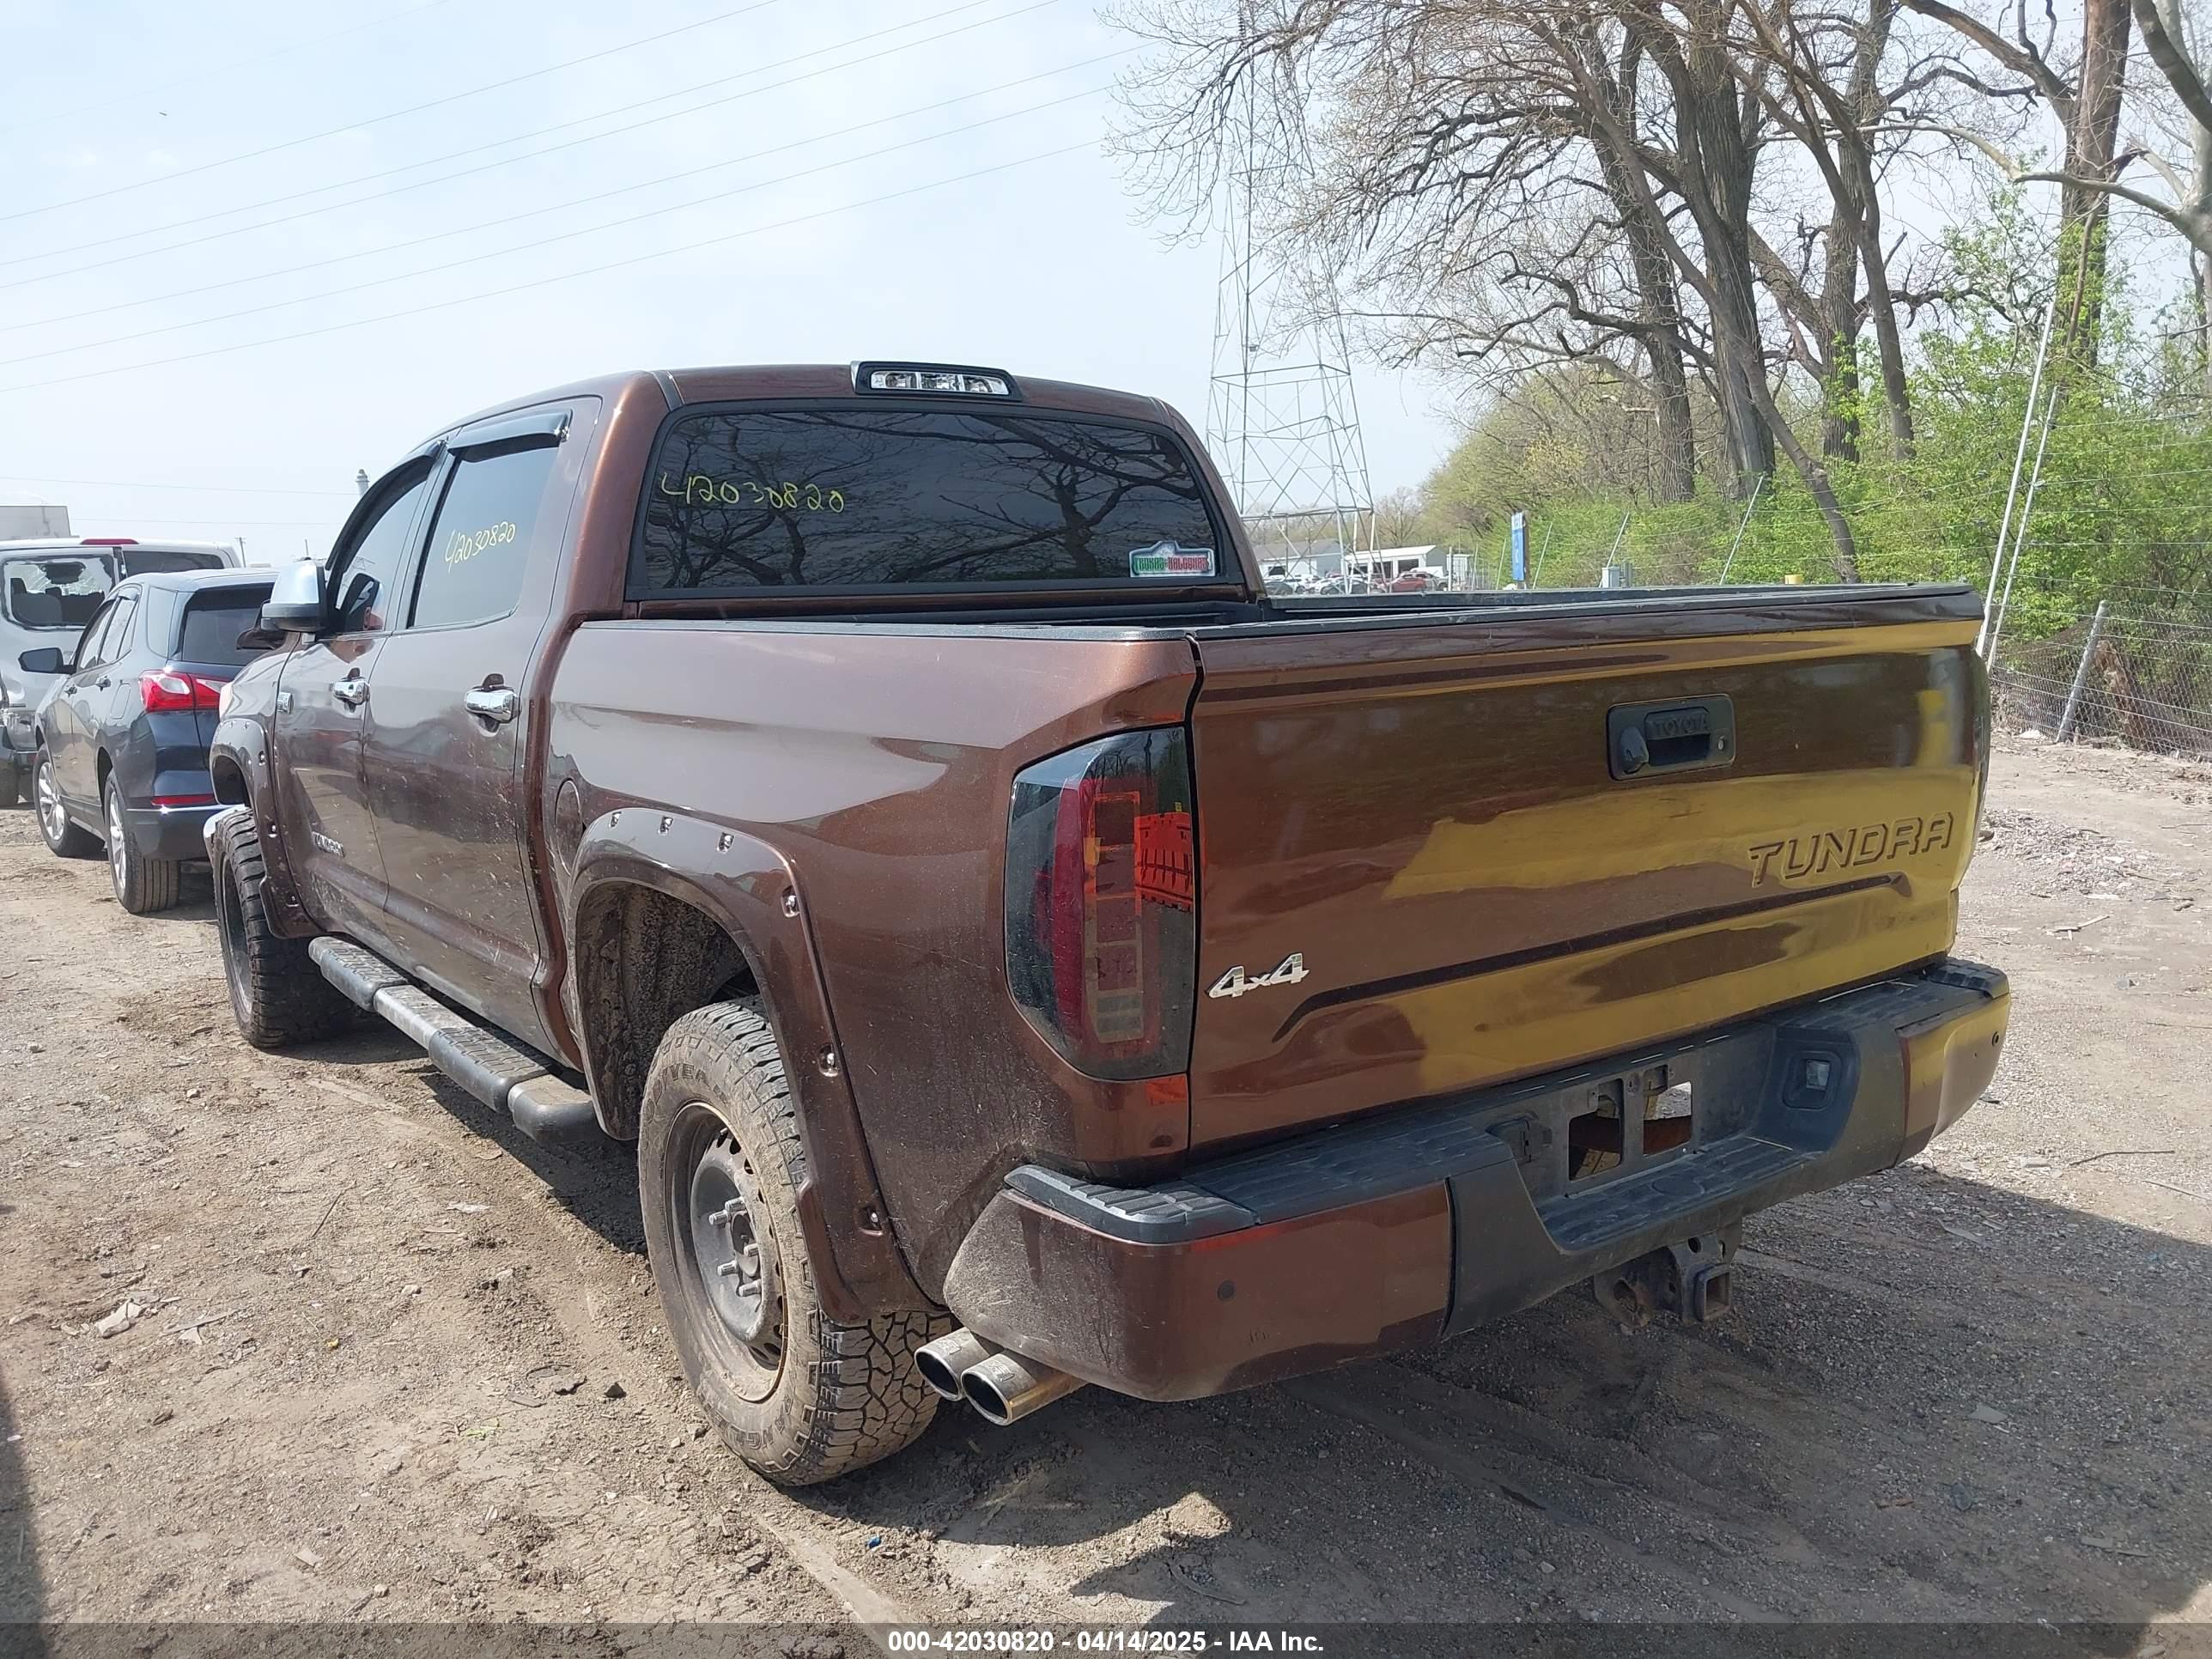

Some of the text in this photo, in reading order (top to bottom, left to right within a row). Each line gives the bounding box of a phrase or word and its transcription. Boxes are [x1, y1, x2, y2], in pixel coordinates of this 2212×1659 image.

[661, 471, 845, 514] 42030820
[445, 520, 516, 574] 42030820
[1653, 713, 1708, 737] TOYOTA
[1747, 811, 1954, 888] TUNDRA
[1206, 952, 1310, 999] 4x4
